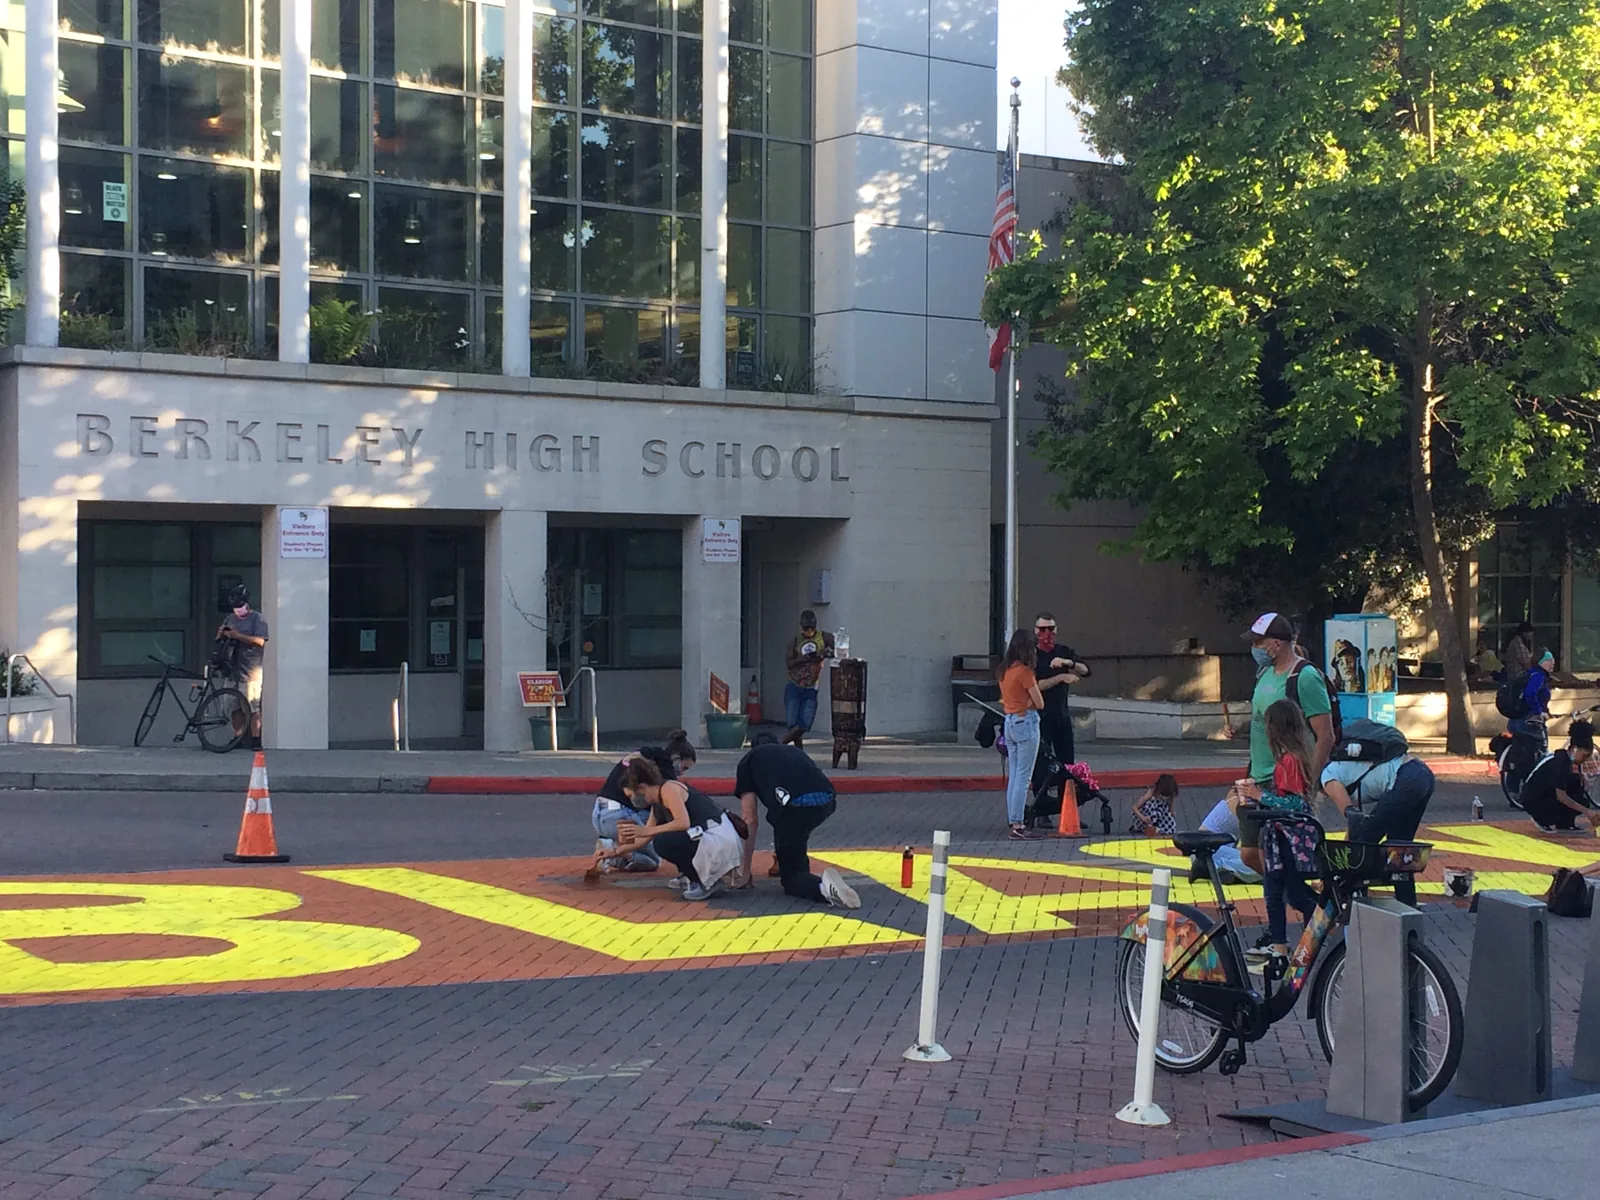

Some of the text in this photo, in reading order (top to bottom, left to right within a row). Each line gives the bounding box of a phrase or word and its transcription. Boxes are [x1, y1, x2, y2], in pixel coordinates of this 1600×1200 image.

[76, 413, 850, 482] BERKELEY HIGH SCHOOL
